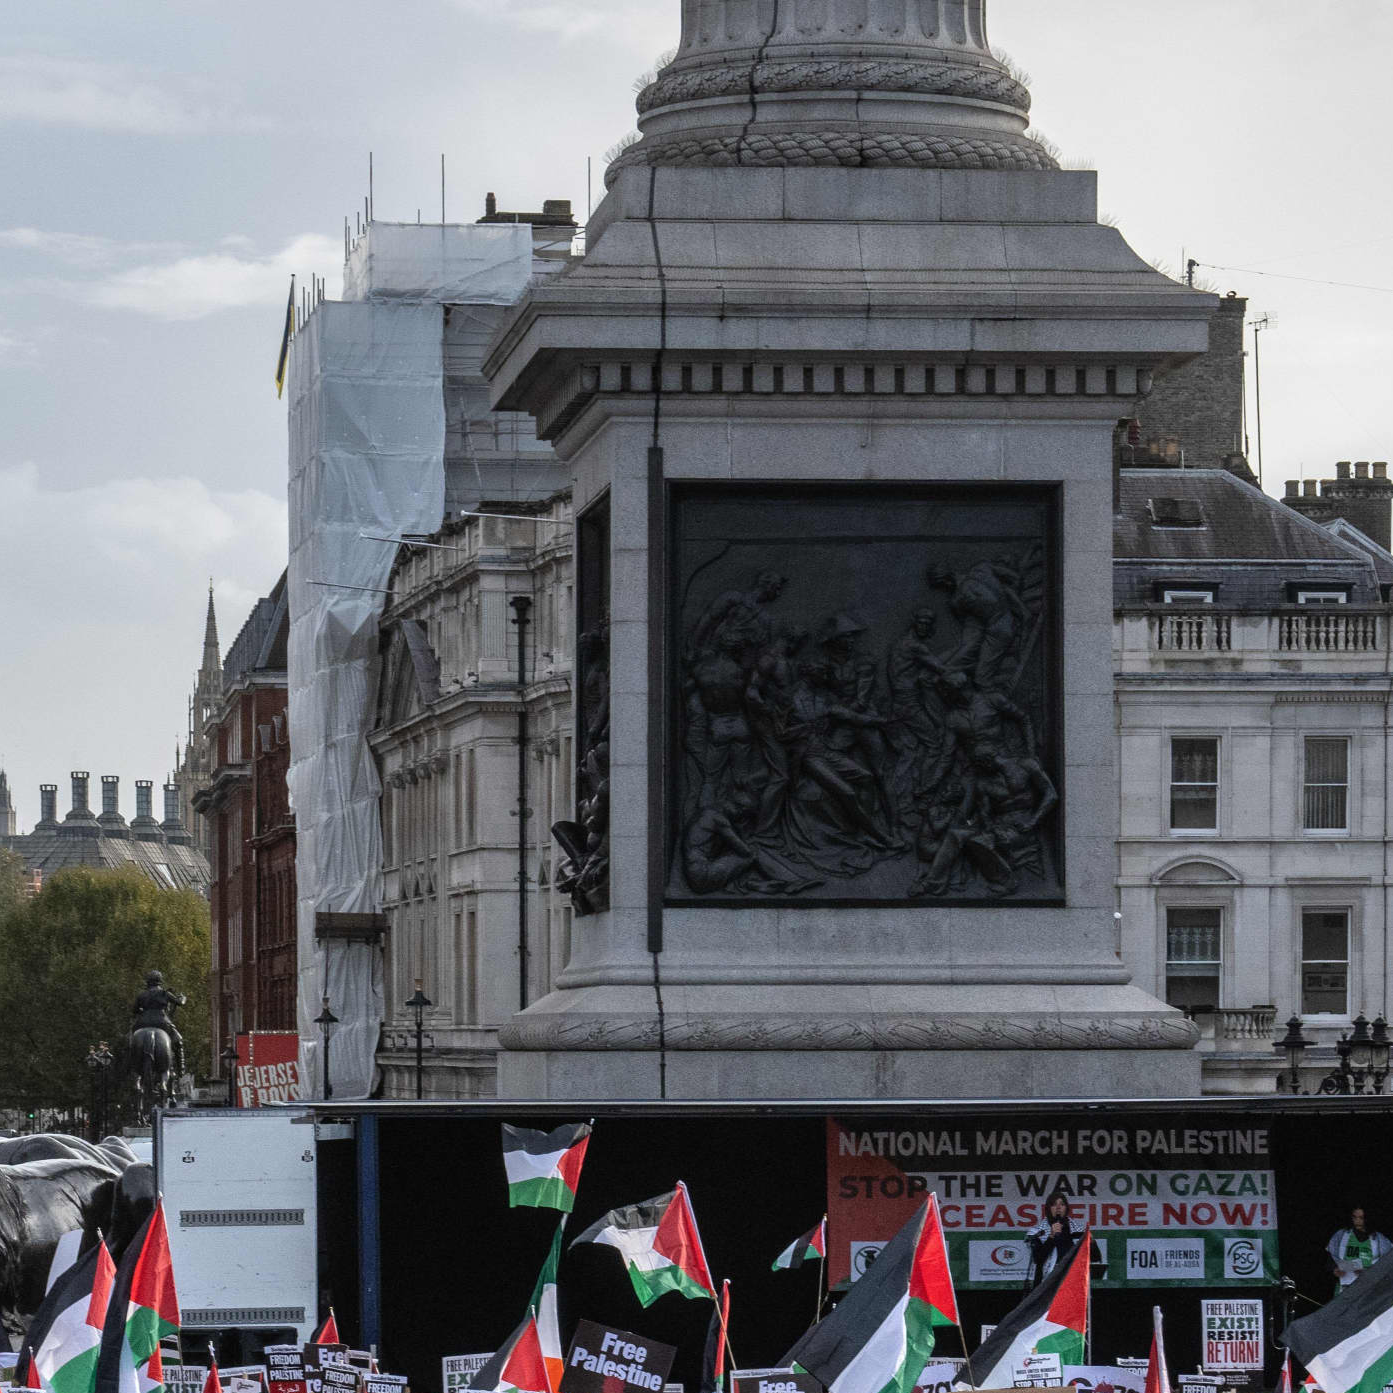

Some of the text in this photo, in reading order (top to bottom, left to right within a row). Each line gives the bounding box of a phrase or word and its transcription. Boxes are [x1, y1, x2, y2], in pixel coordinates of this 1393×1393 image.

[838, 1130, 1269, 1156] NATIONAL MARCH FOR PALESTINE
[838, 1173, 1269, 1199] STOP THE WAR ON GAZA!
[941, 1202, 1269, 1228] CEASFIRE NOW!
[1130, 1249, 1200, 1268] FOA FRIENDS
[1232, 1251, 1255, 1266] PSC
[1206, 1303, 1260, 1316] FREE PALESTINE
[1206, 1316, 1260, 1330] EXIST!
[600, 1331, 649, 1363] Free
[1206, 1330, 1260, 1341] RESIST!
[1207, 1341, 1260, 1364] RETURN!
[570, 1346, 663, 1393] Palestine
